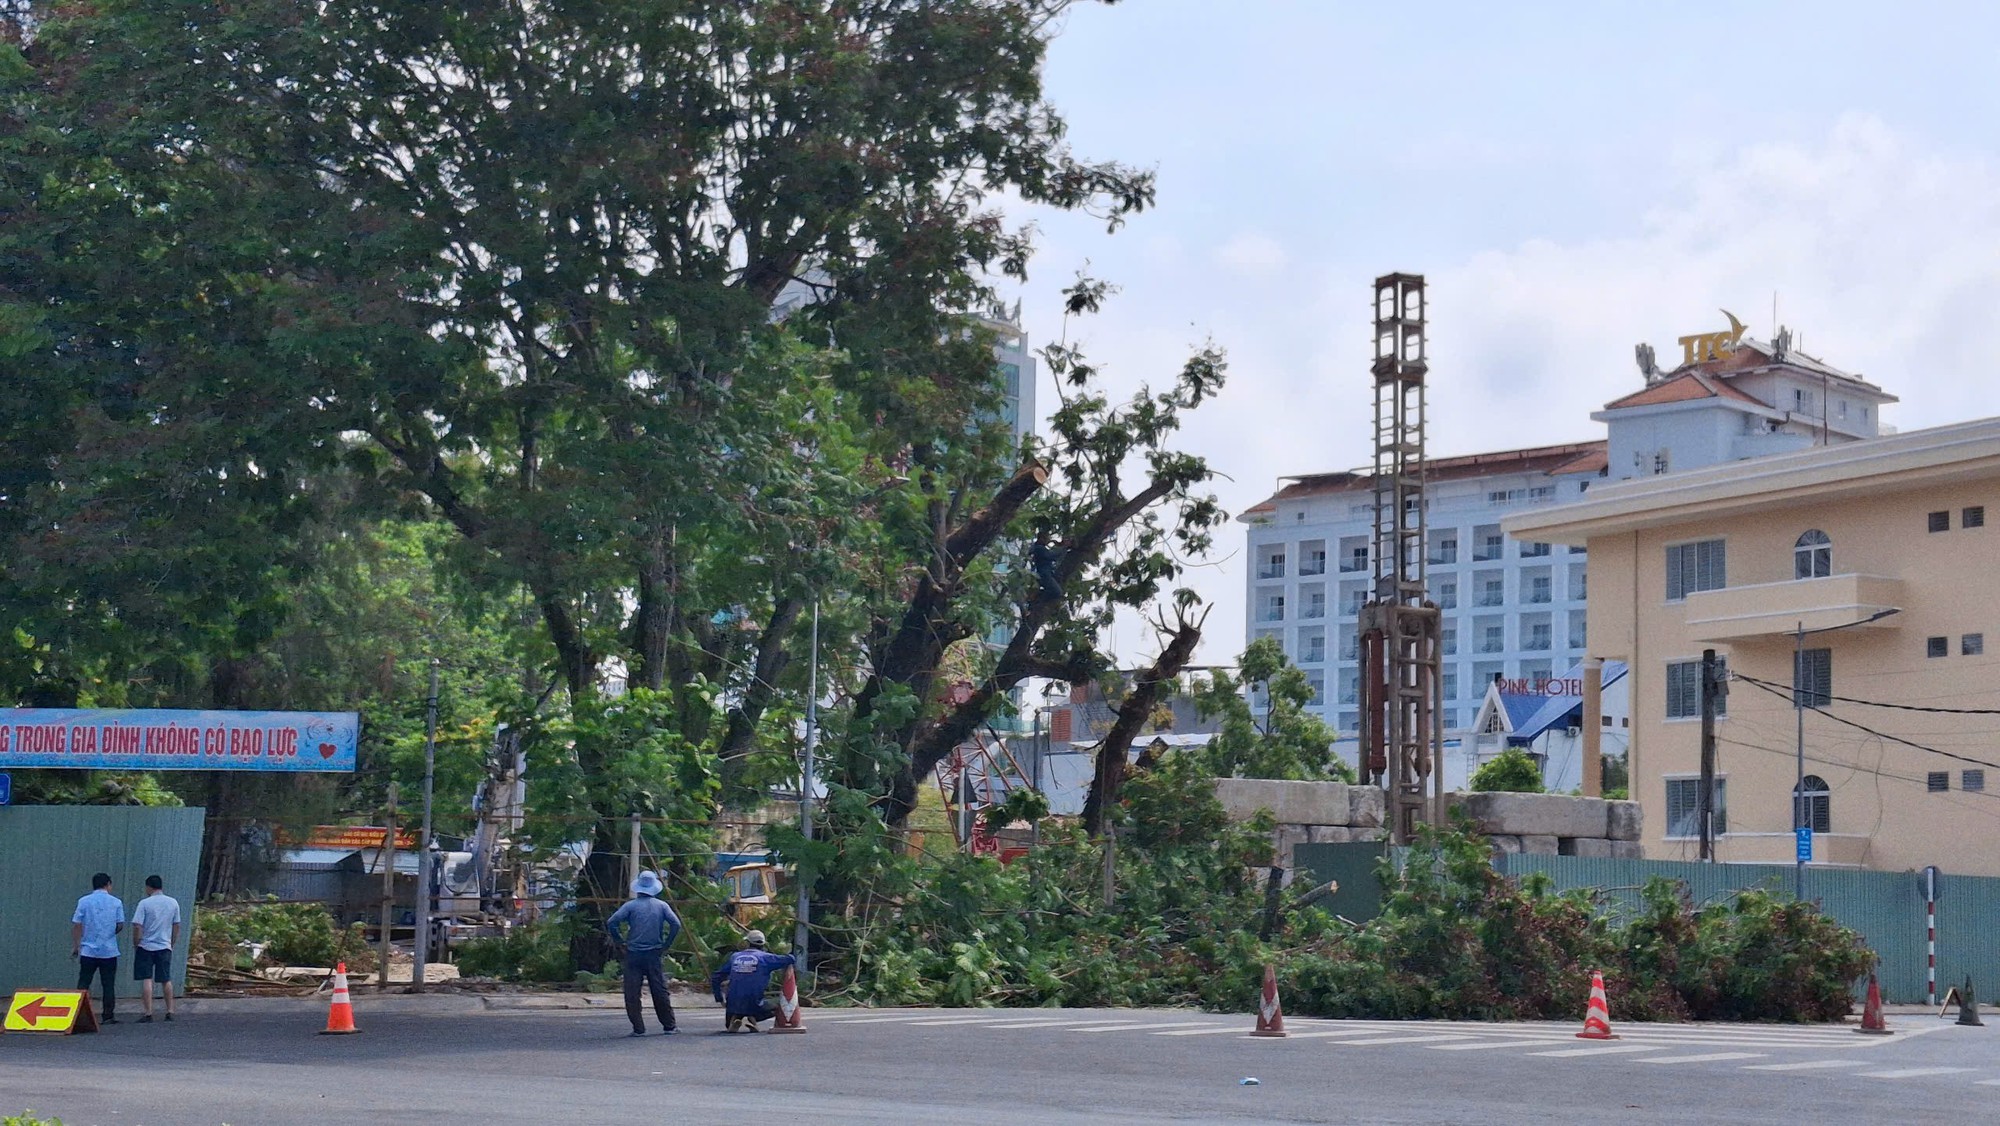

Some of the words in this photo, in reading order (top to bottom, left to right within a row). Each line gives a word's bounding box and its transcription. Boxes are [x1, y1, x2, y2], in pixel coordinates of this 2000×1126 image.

[1678, 331, 1736, 364] TTC
[1499, 678, 1530, 695] PINK
[1536, 678, 1583, 696] HOTEL
[15, 725, 66, 753] TRONG
[71, 726, 97, 754] GIA
[102, 721, 141, 754] ĐÌNH
[145, 722, 199, 755] KHÔNG
[205, 722, 226, 756] CÓ
[231, 728, 263, 762] BẠO
[267, 727, 298, 762] LỰC
